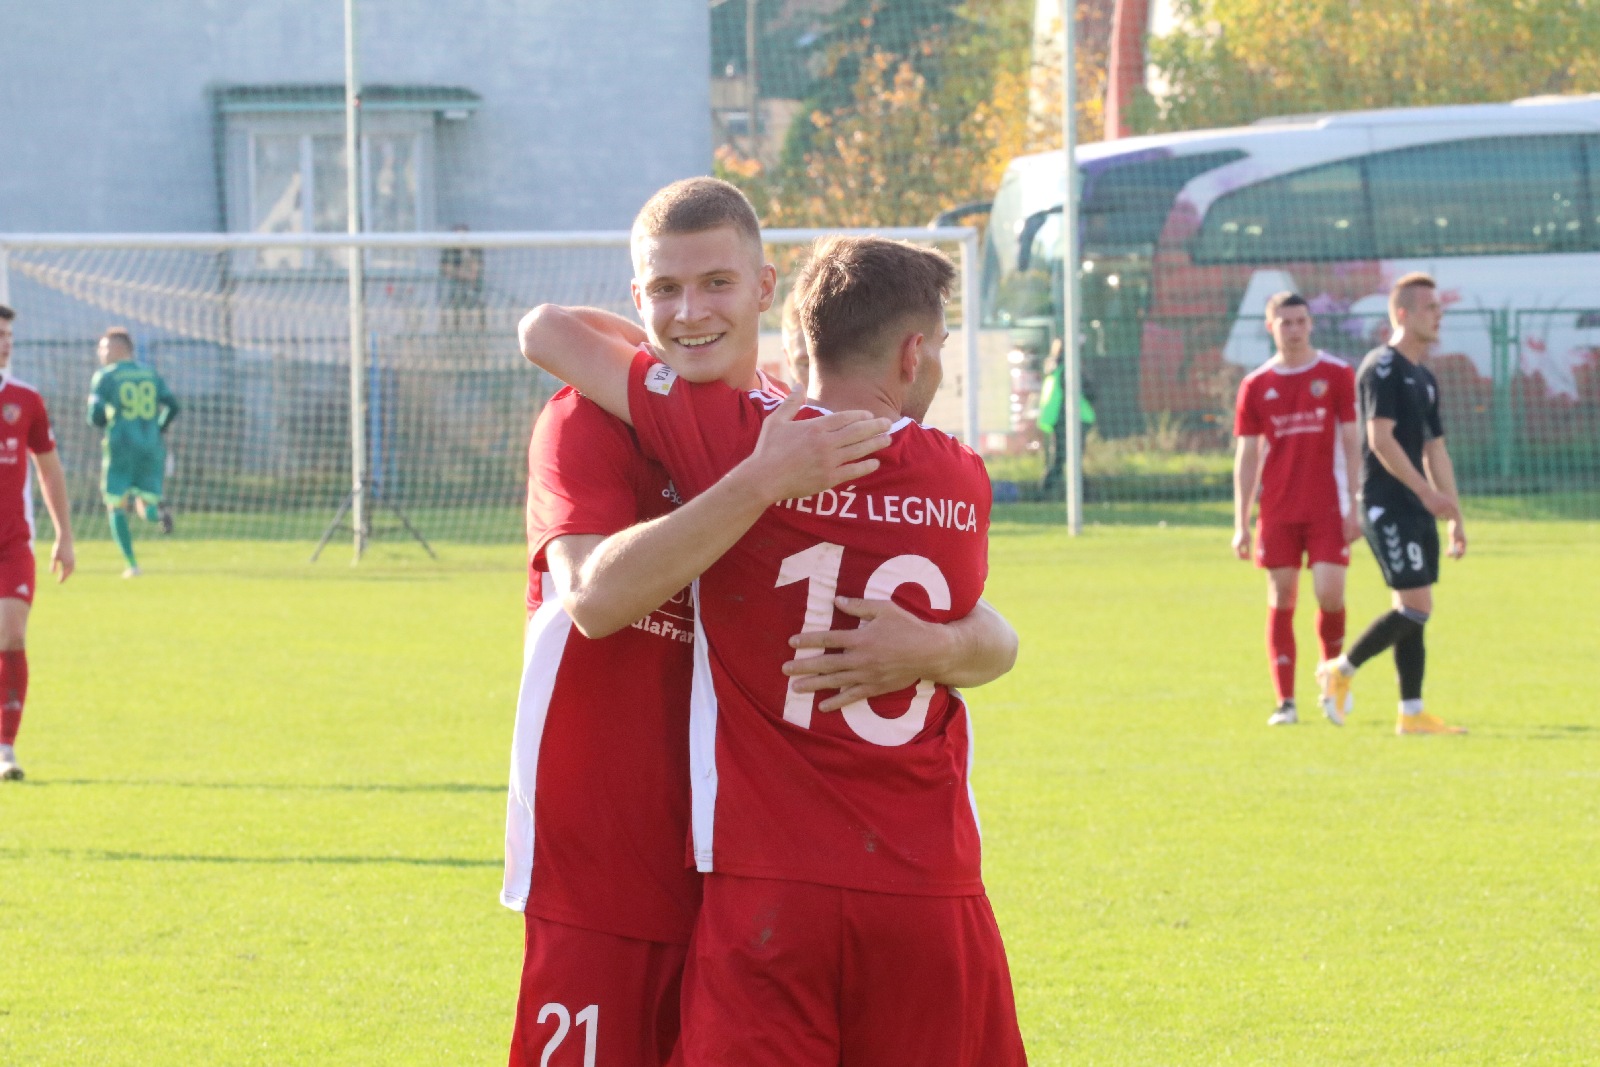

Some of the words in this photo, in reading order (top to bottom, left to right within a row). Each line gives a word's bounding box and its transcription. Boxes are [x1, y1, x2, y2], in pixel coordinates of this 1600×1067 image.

[119, 381, 156, 420] 98
[867, 494, 977, 533] LEGNICA
[1407, 542, 1423, 570] 9
[537, 1003, 599, 1067] 21
